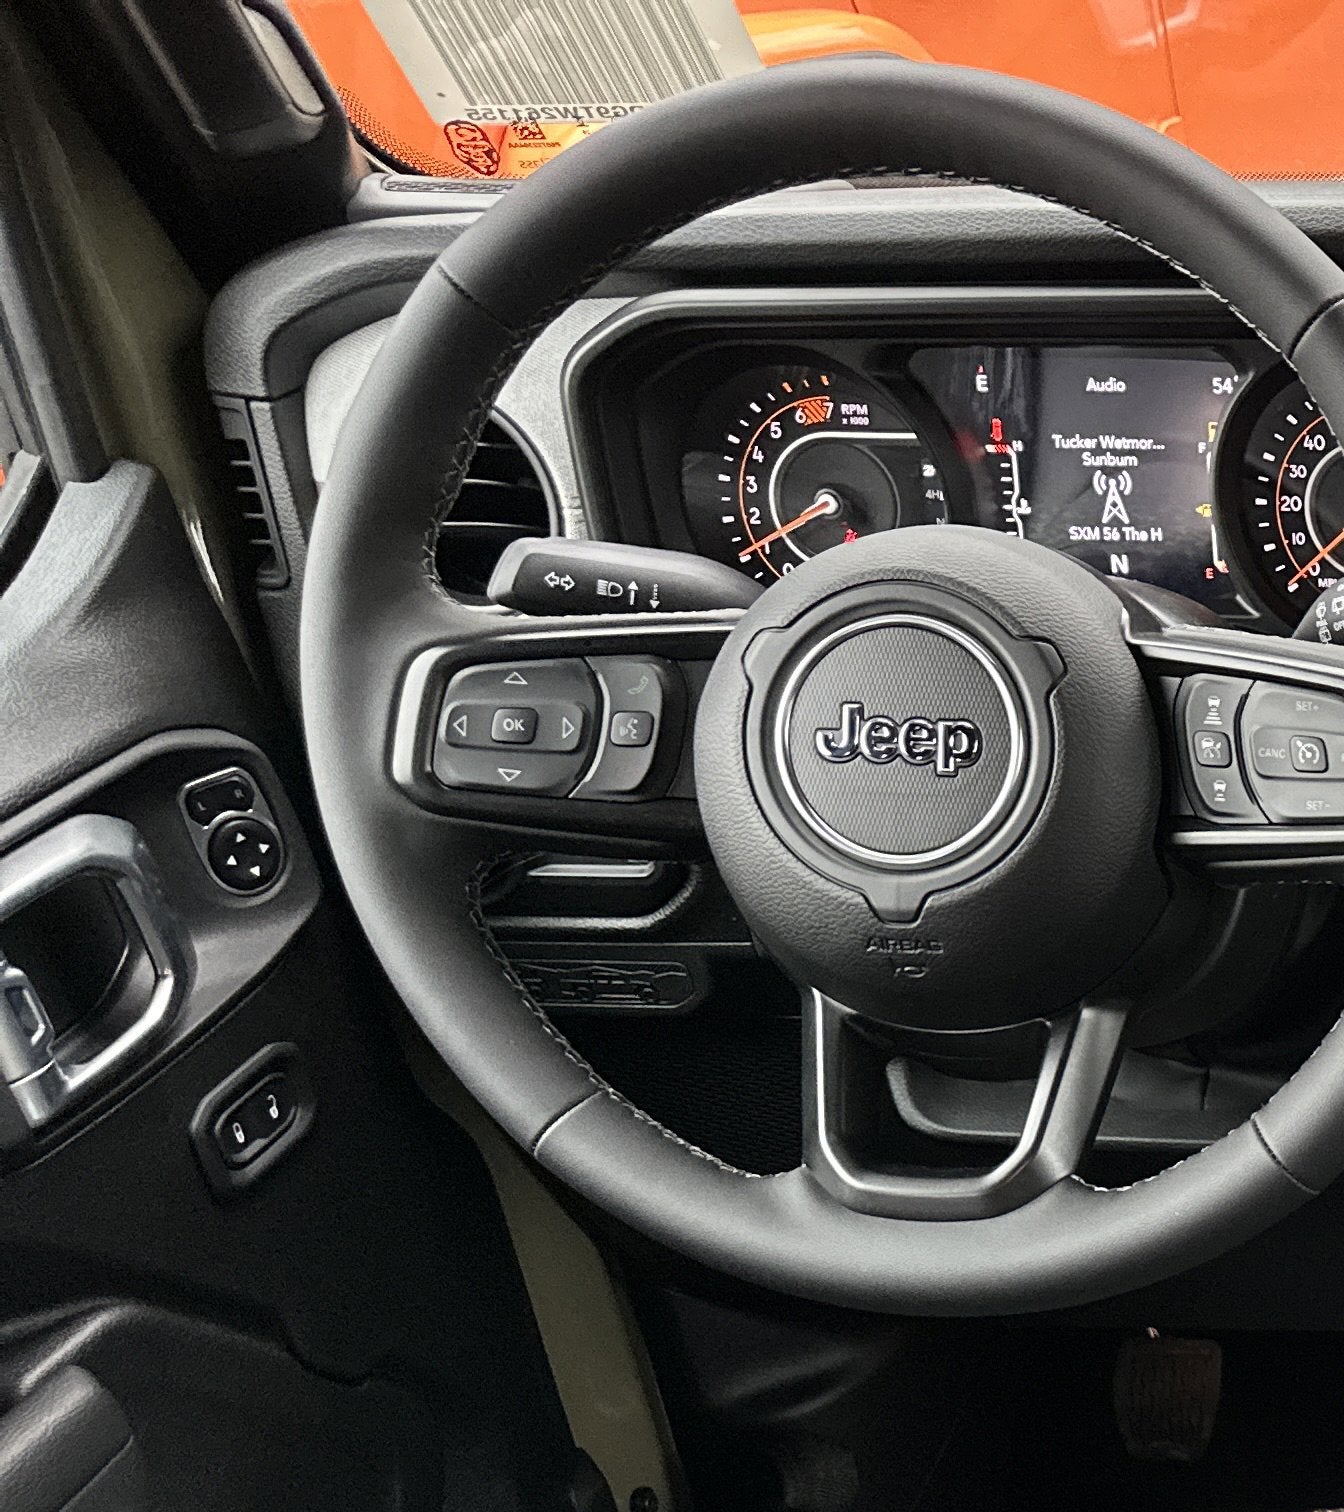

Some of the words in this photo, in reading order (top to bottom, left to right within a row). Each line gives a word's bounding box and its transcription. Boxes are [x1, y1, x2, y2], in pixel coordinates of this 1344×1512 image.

[1086, 377, 1126, 392] Audio
[795, 408, 806, 424] 6
[824, 402, 834, 419] 7
[841, 404, 868, 415] RPM
[770, 422, 782, 438] 5
[1052, 435, 1097, 449] Tucker
[1303, 434, 1326, 451] 40
[752, 446, 764, 462] 4
[1082, 453, 1138, 467] Sunburn
[1289, 464, 1308, 479] 30
[746, 476, 757, 493] 3
[1280, 496, 1302, 512] 20
[750, 508, 761, 524] 2
[1069, 527, 1099, 541] SXM
[1103, 527, 1121, 541] 56
[1122, 527, 1148, 541] The
[1151, 527, 1163, 541] H
[1292, 532, 1306, 546] 10
[1110, 554, 1129, 573] N
[503, 718, 525, 732] OK
[815, 701, 983, 777] Jeep
[1258, 748, 1286, 759] CANC
